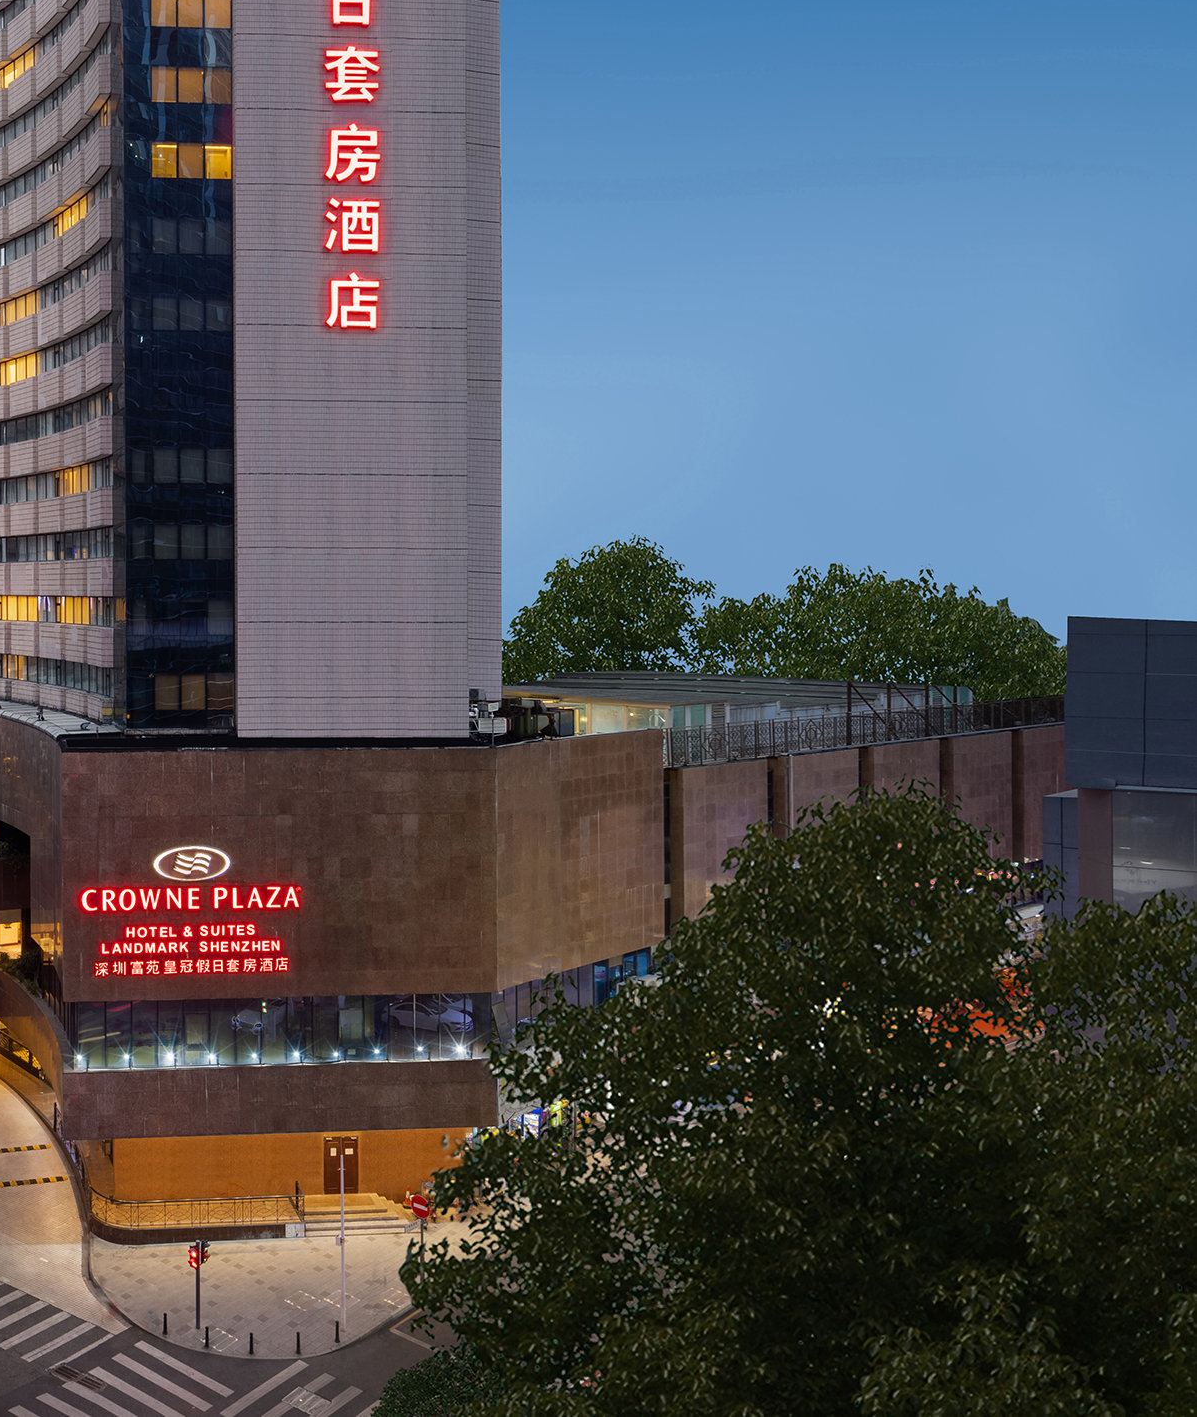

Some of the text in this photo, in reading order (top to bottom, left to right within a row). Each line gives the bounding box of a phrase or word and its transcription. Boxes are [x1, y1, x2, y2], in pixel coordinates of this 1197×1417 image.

[81, 886, 300, 912] CROWNE PLAZA
[126, 924, 256, 938] HOTEL & SUITES
[101, 940, 281, 954] LANDMARK SHENZHEN
[94, 957, 290, 977] 深圳富苑皇冠假日套房酒店
